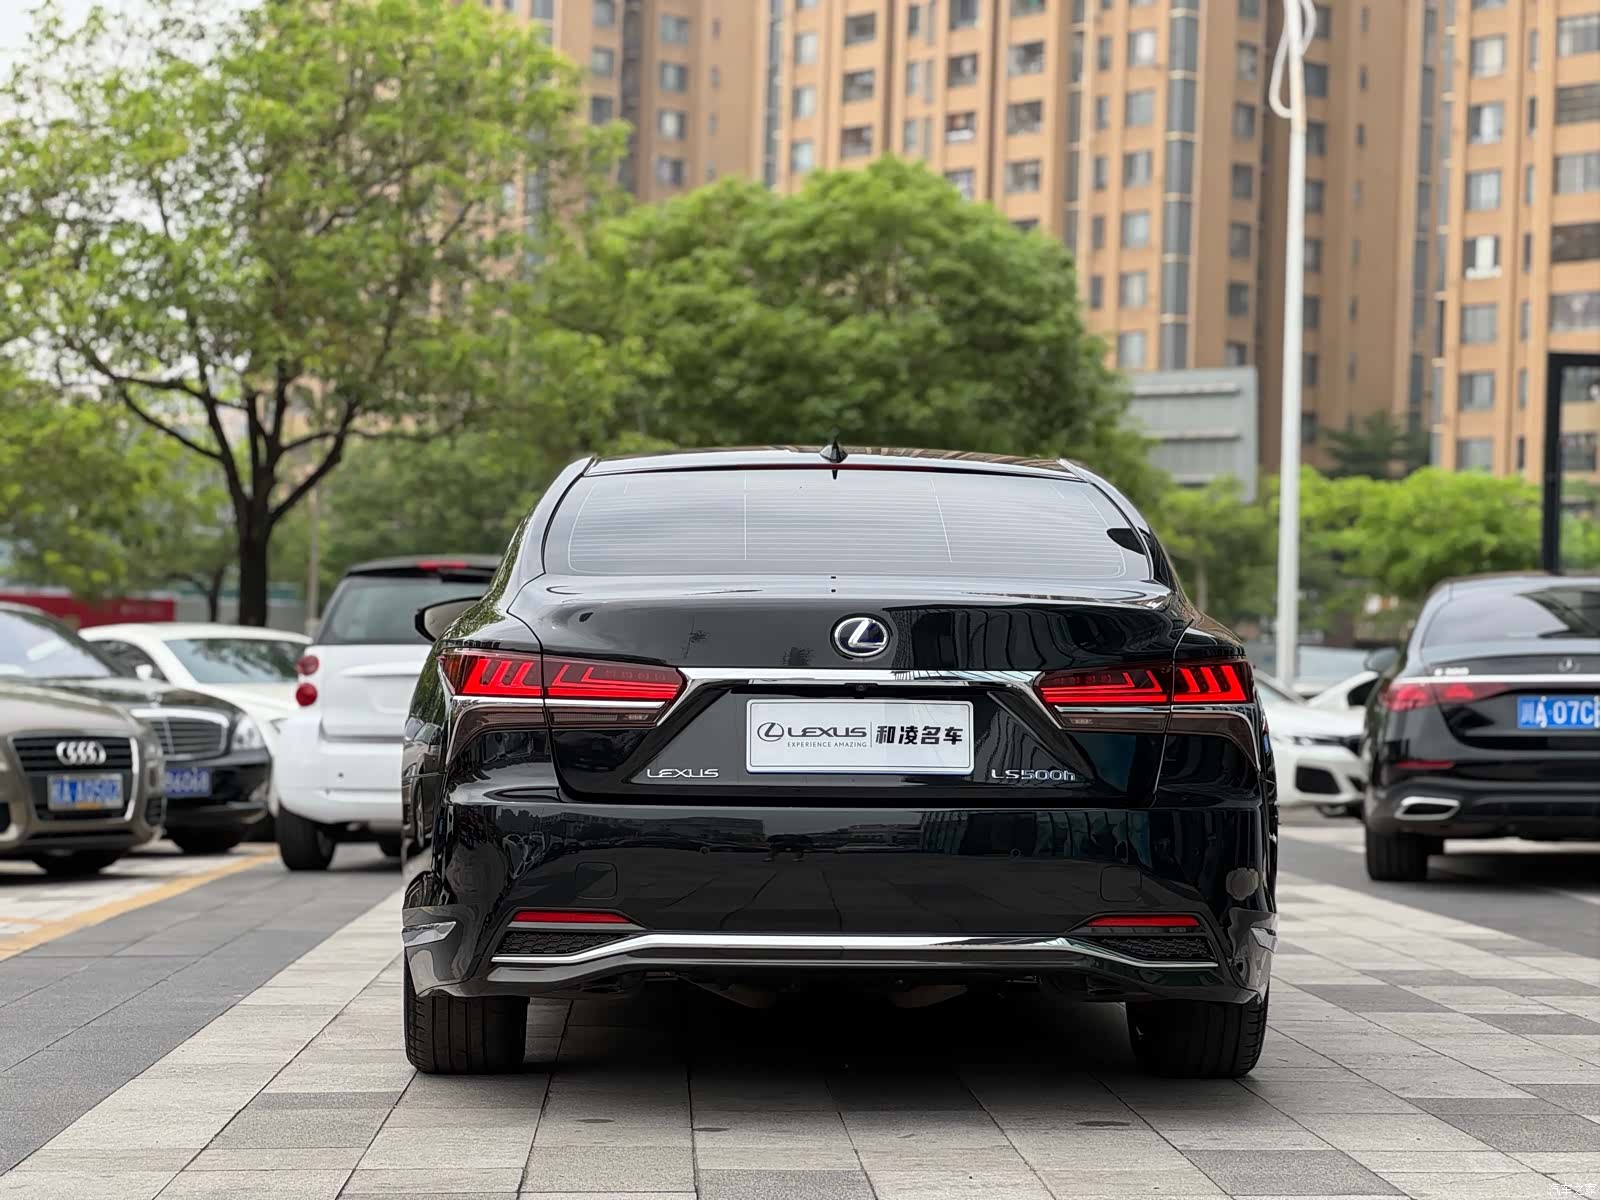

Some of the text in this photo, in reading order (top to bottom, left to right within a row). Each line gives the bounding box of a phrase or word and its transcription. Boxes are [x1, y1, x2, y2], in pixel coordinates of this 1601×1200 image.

[787, 726, 868, 738] LEXUS
[875, 725, 964, 745] 和凌名车
[646, 768, 719, 778] LEXUS
[991, 768, 1076, 781] LS500h
